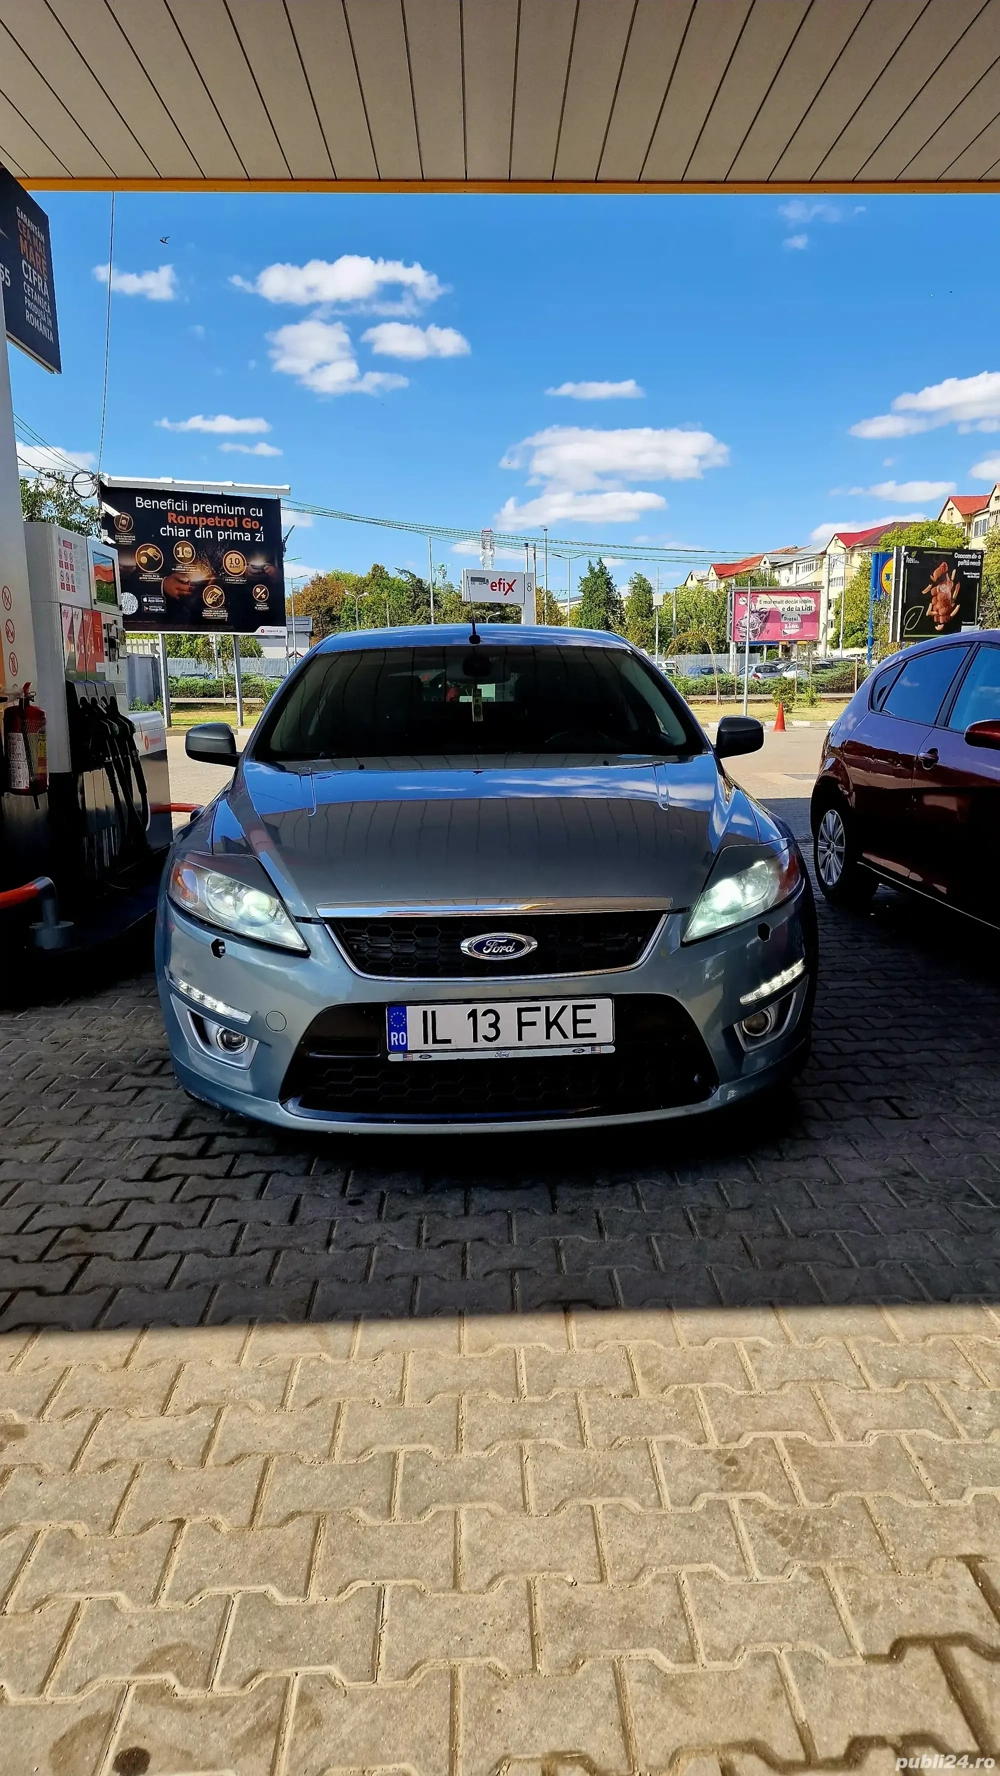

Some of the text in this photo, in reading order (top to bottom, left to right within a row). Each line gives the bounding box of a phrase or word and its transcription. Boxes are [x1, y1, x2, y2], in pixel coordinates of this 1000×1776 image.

[20, 235, 47, 278] MARE
[135, 496, 263, 517] Beneficii premium cu
[167, 512, 264, 532] Rompetrol Go,
[160, 525, 264, 542] chiar din prima zi
[490, 577, 517, 596] efix
[526, 582, 533, 592] 8
[482, 939, 516, 954] Ford
[422, 1004, 597, 1045] IL 13 FKE
[390, 1032, 407, 1046] RO
